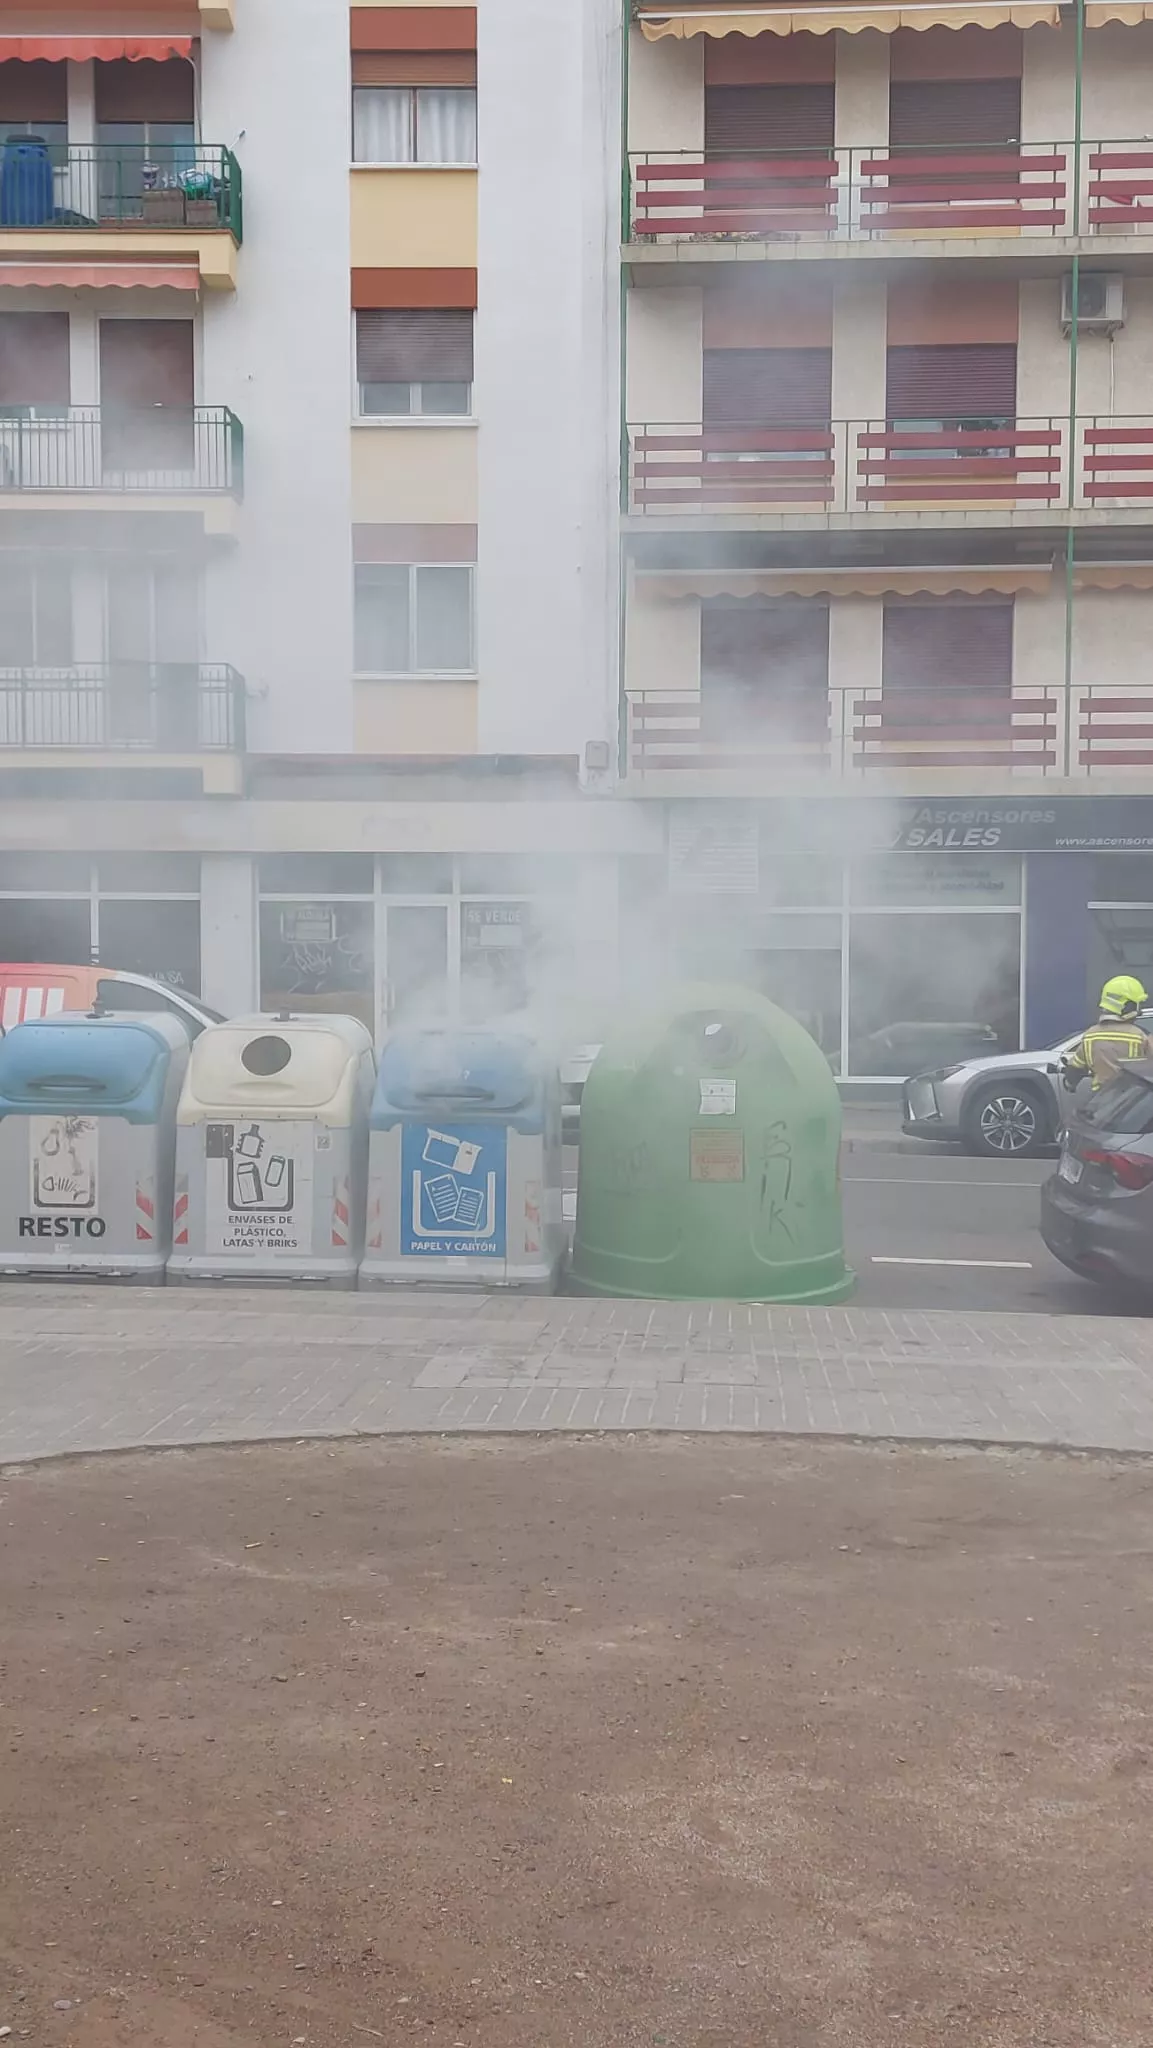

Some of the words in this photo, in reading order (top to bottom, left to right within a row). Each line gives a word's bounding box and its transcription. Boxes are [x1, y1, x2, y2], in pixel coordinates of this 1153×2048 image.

[915, 807, 1056, 824] Ascensores
[906, 827, 1002, 847] SALES
[228, 1215, 276, 1224] ENVASES
[278, 1215, 293, 1224] DE
[19, 1217, 106, 1237] RESTO
[223, 1239, 254, 1248] LATAS
[256, 1239, 264, 1248] Y
[267, 1239, 298, 1248] BRIKS
[411, 1241, 442, 1251] PAPEL
[444, 1242, 451, 1251] Y
